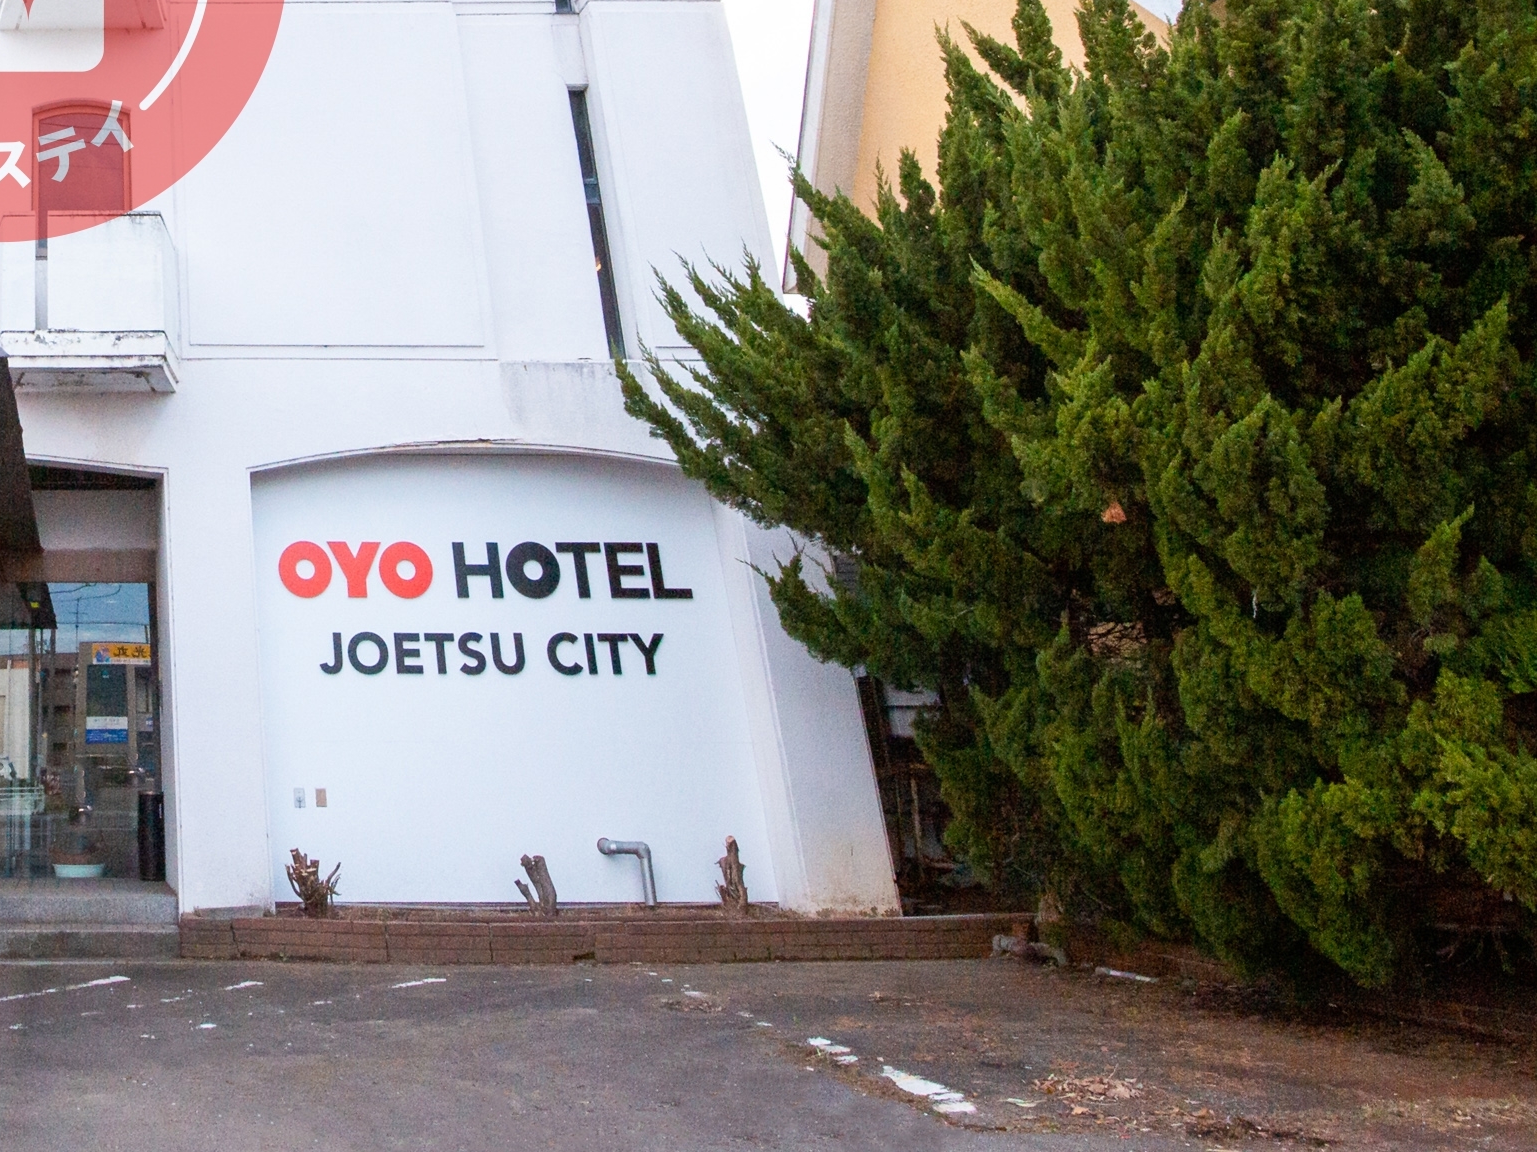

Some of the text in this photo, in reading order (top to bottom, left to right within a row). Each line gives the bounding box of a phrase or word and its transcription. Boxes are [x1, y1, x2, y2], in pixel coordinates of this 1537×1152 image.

[278, 540, 694, 600] OYO HOTEL
[319, 631, 665, 677] JOETSU CITY
